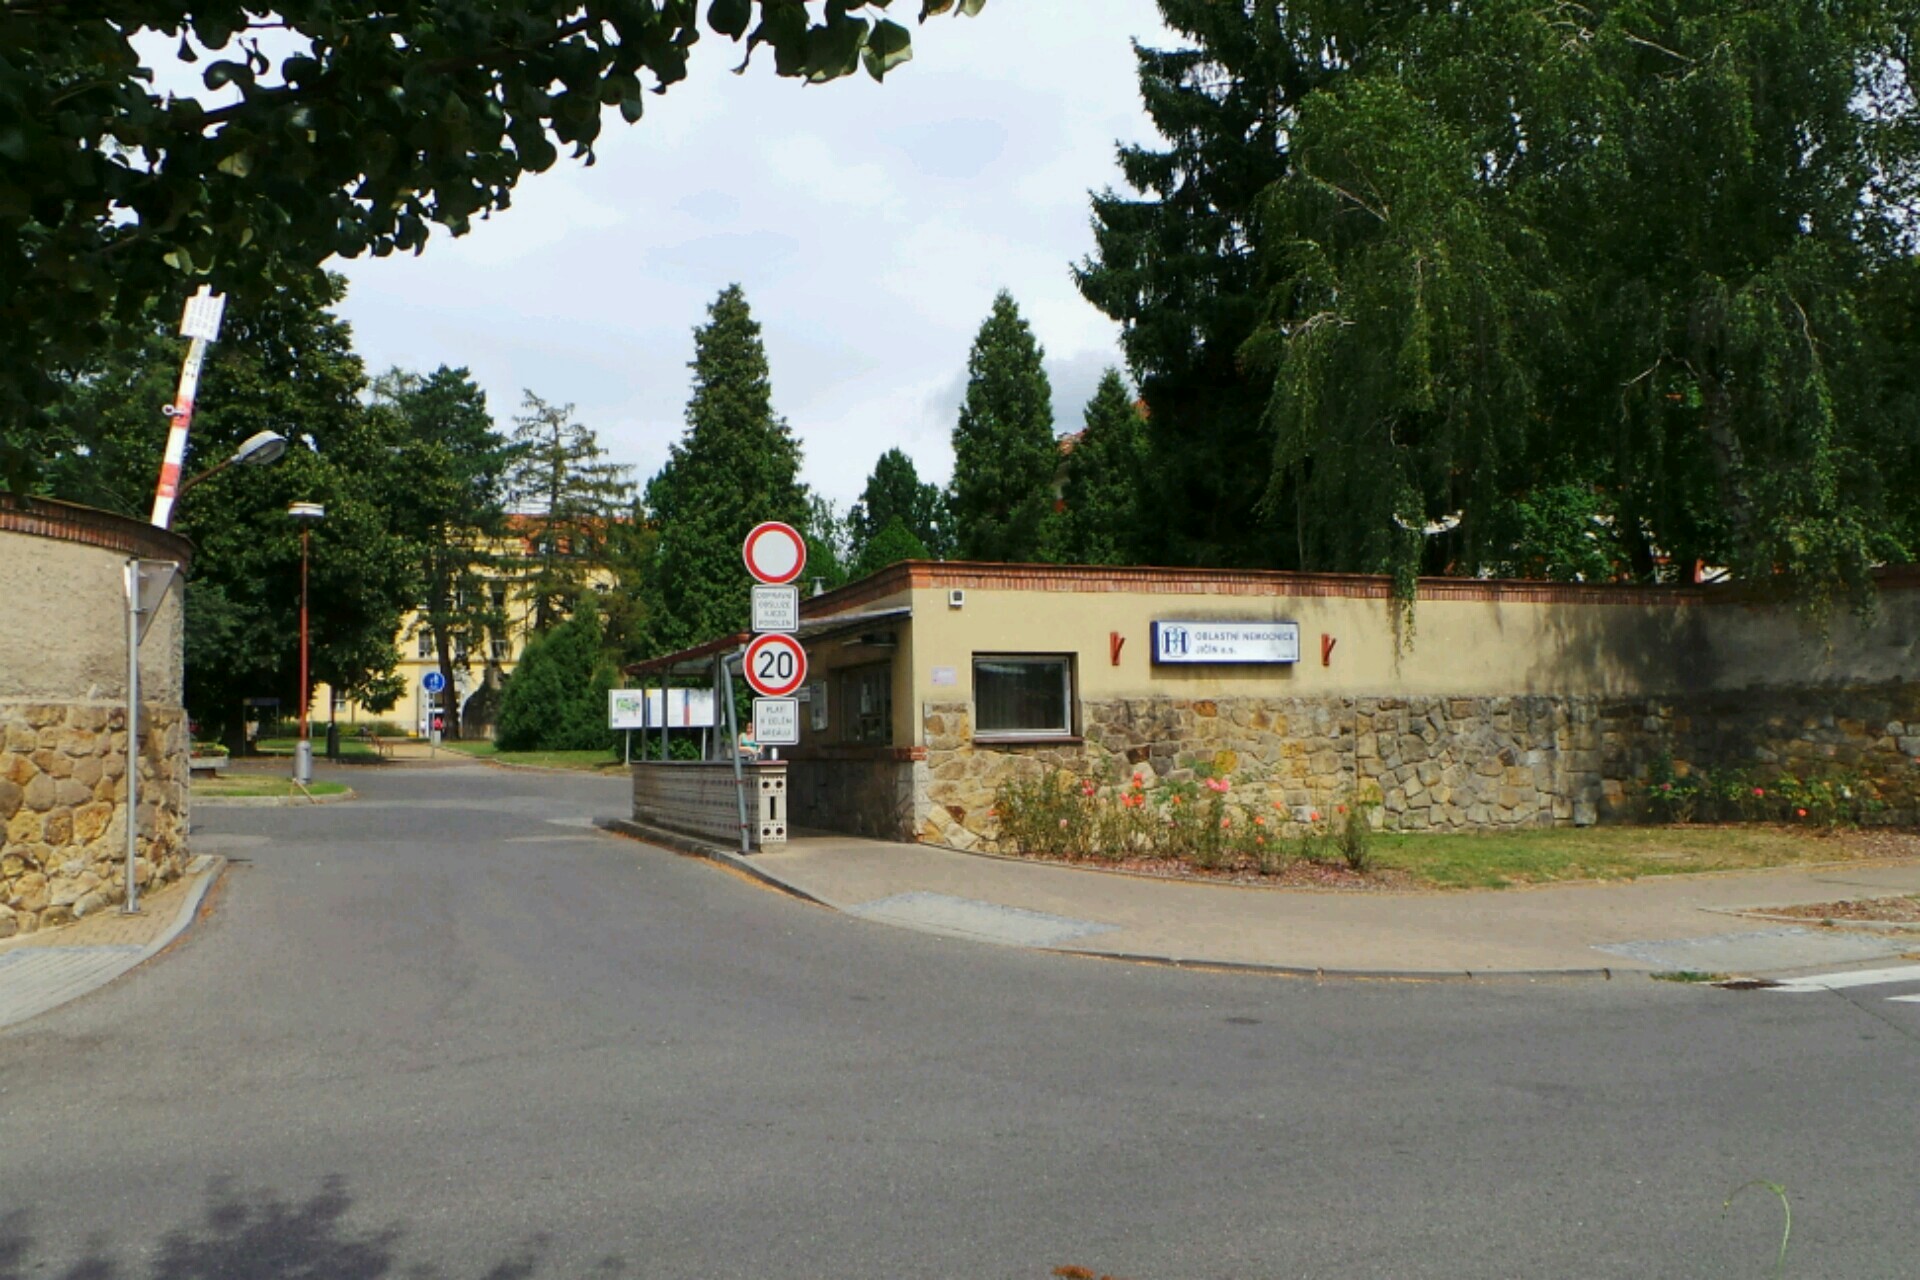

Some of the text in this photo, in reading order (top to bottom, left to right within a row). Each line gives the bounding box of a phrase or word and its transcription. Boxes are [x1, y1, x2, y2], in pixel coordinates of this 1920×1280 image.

[1194, 630, 1295, 641] OBLASTNÍ NEMOCNICE
[759, 651, 793, 679] 20
